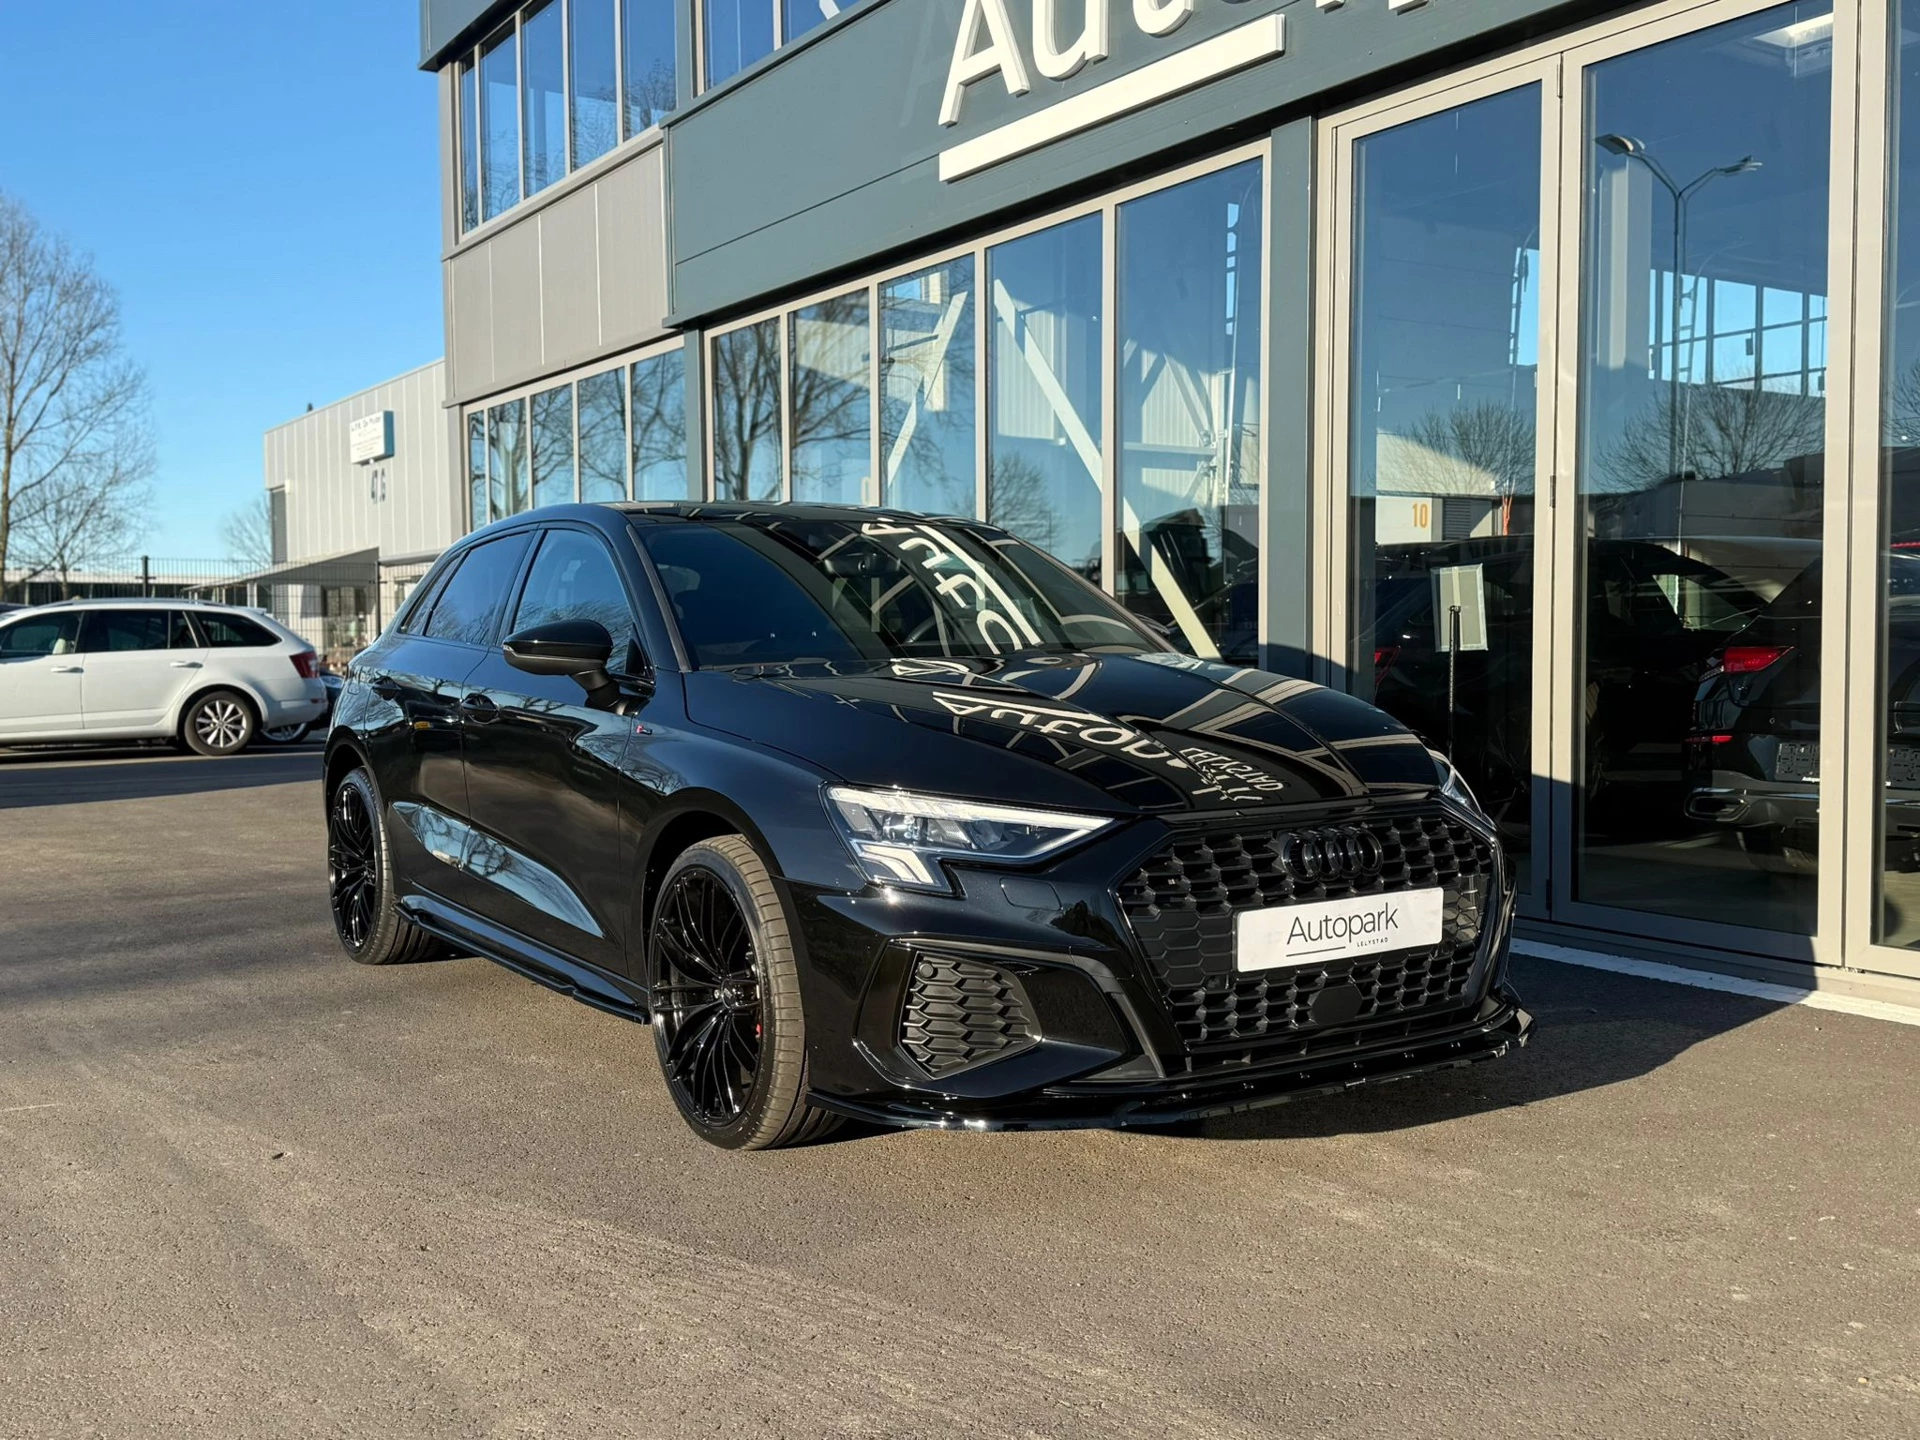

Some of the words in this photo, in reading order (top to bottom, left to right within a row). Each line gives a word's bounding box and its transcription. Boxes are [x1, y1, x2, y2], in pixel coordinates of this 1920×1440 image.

[1412, 503, 1428, 528] 10
[1287, 902, 1399, 943] Autopark
[1356, 936, 1389, 947] LELYSTAD
